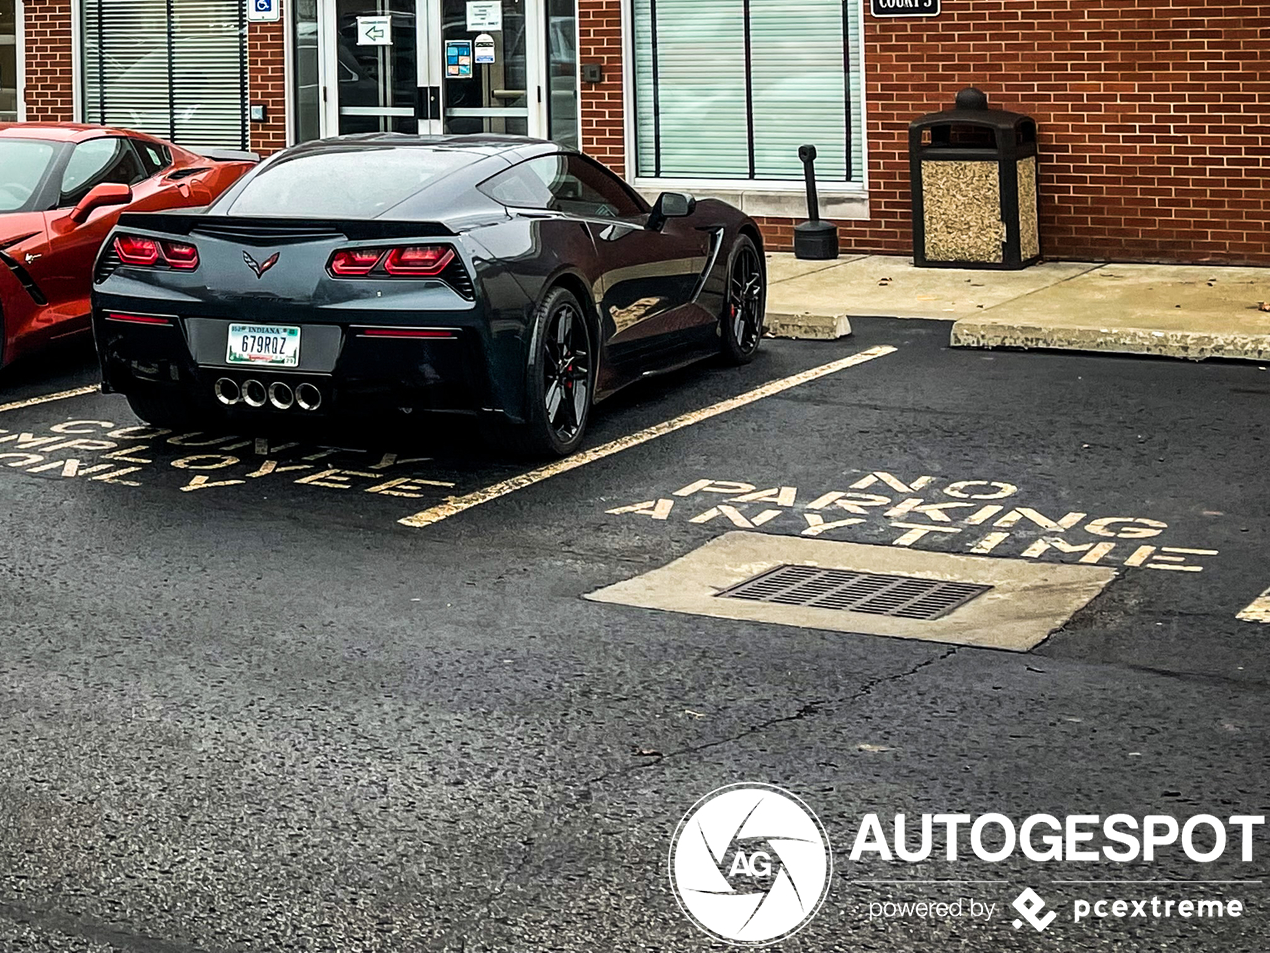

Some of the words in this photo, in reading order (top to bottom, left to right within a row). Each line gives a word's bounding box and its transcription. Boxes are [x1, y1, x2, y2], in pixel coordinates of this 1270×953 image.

[248, 326, 280, 335] INDIANA
[849, 471, 1018, 500] NO
[672, 478, 1168, 538] PARKING
